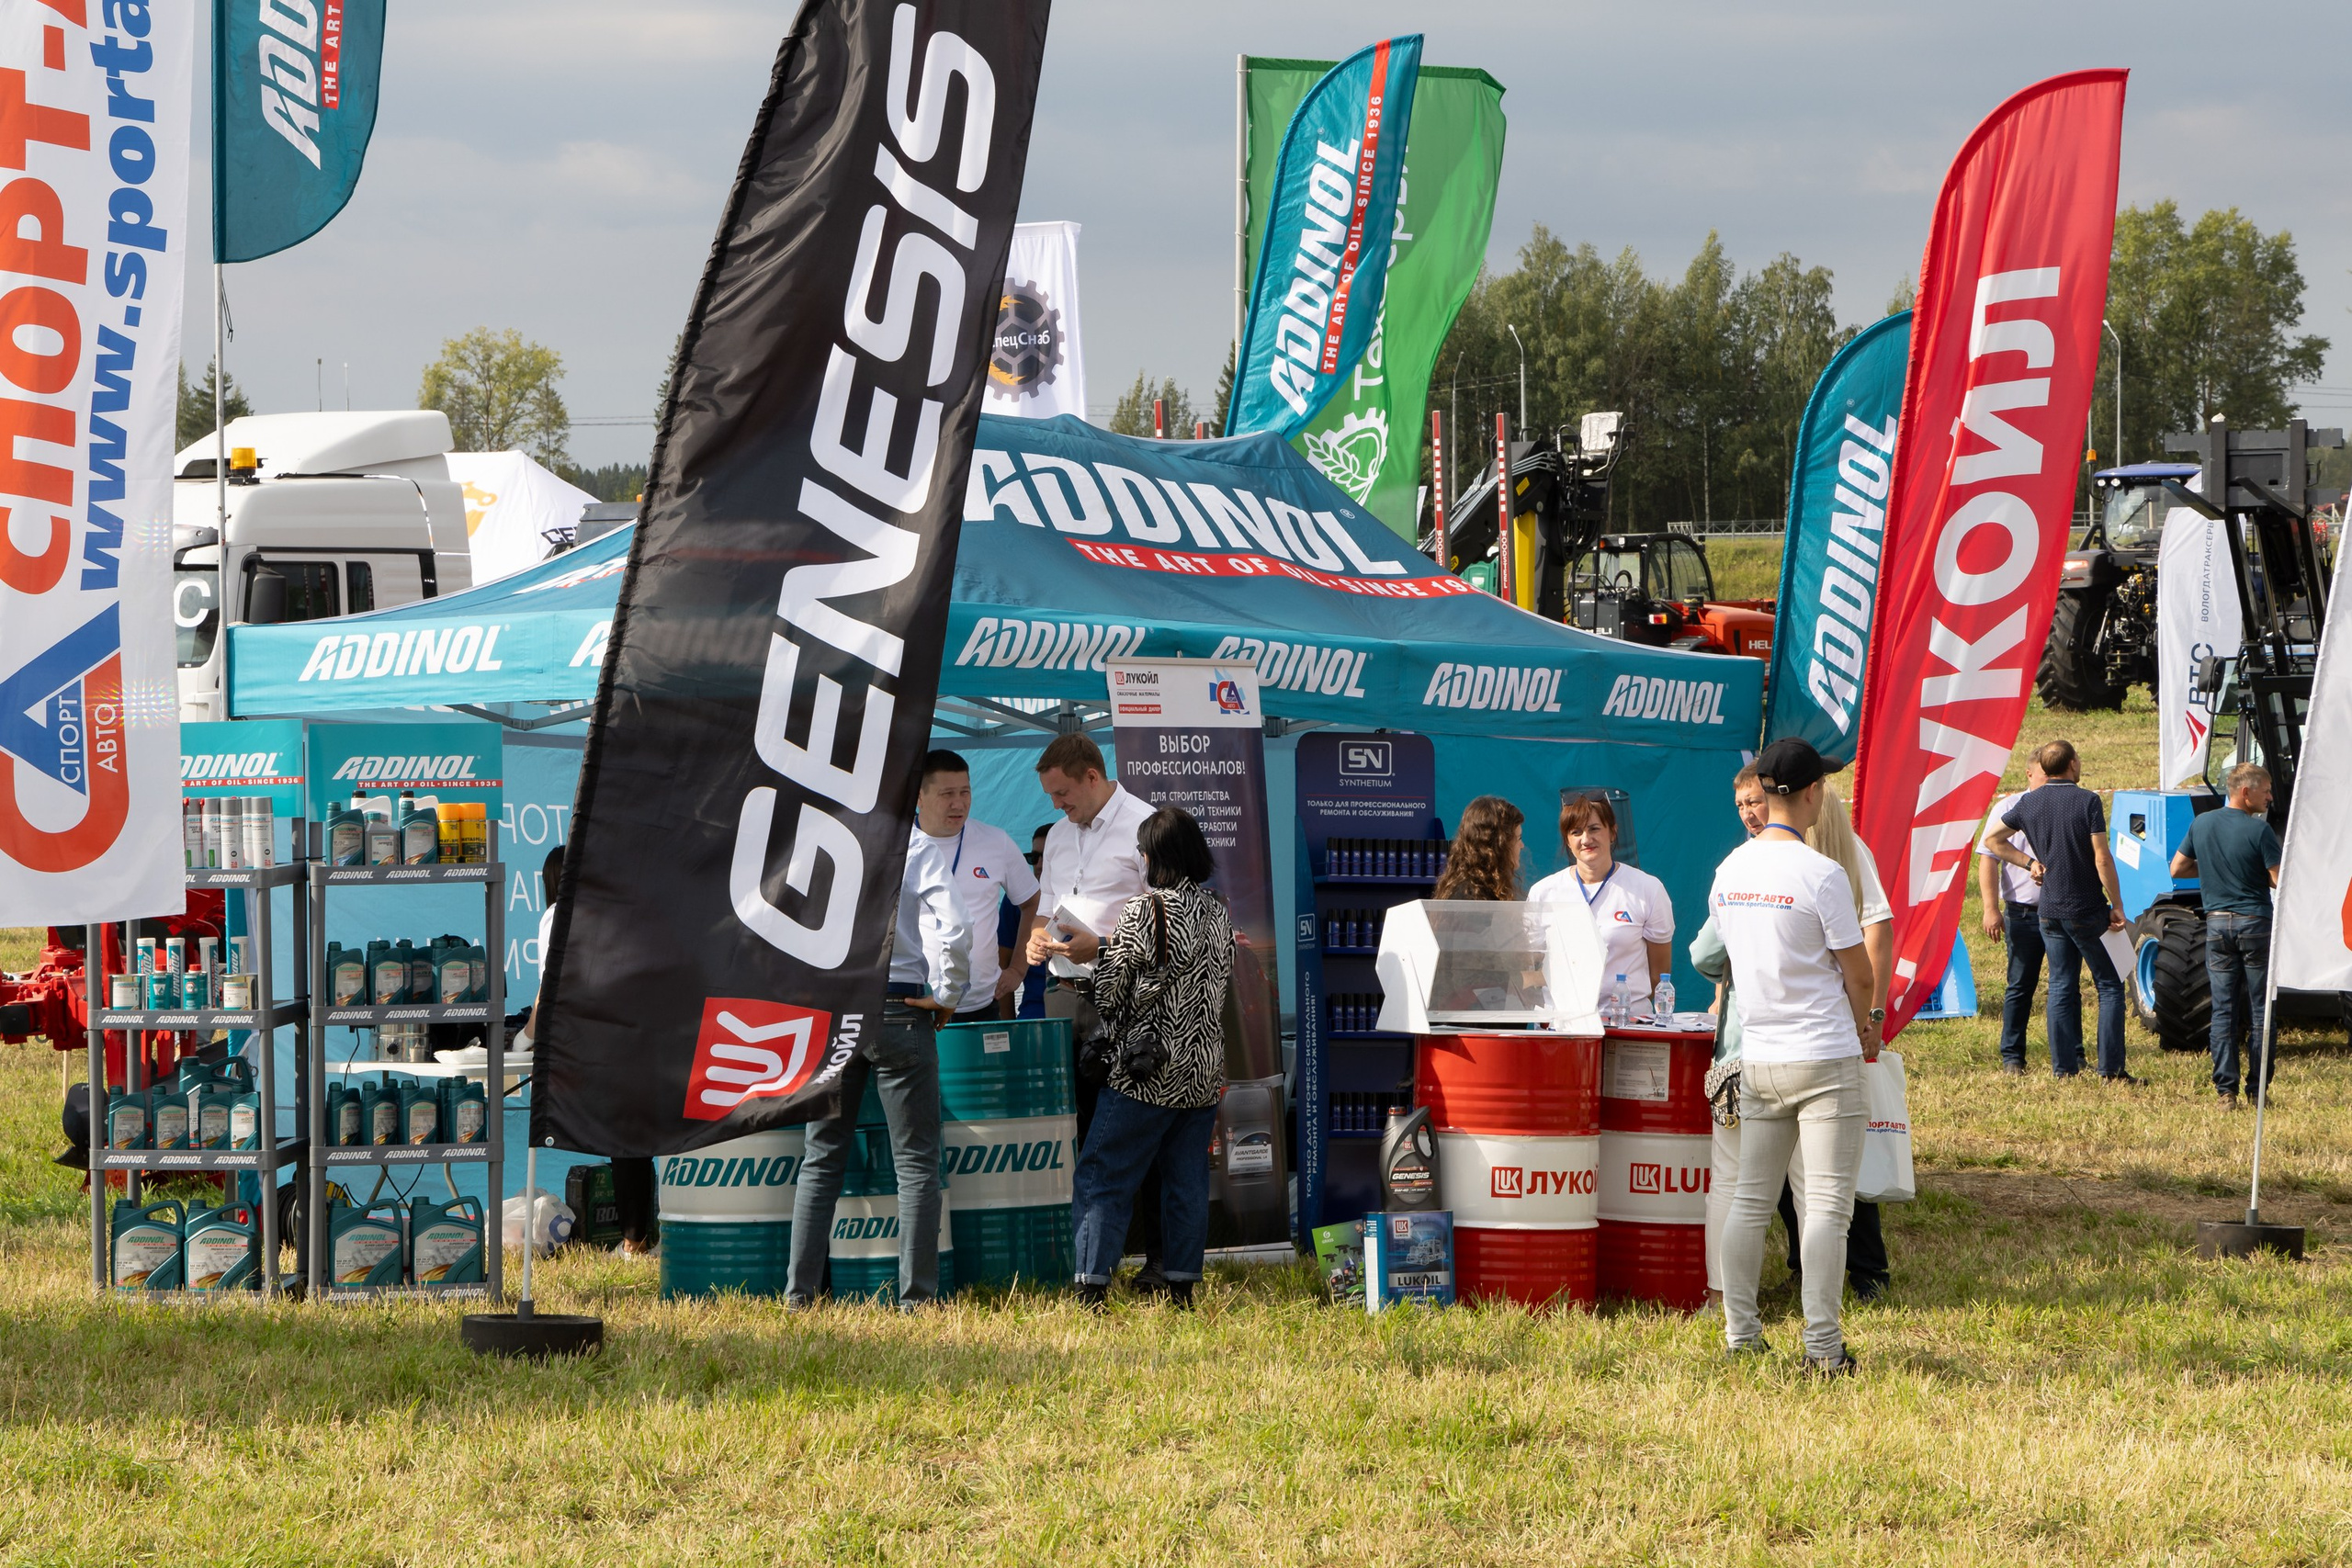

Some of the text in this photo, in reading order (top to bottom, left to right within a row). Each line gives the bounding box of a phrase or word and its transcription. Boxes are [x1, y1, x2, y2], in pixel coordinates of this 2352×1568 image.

[323, 5, 342, 105] THE ART
[1323, 335, 1340, 370] THE
[1332, 291, 1348, 325] ART
[1341, 262, 1354, 283] OF
[1366, 96, 1382, 139] 1936
[1271, 138, 1360, 416] ADDINOL
[993, 330, 1051, 349] пецСнаб
[729, 3, 996, 970] GENESIS
[963, 448, 1408, 575] ADDINOL
[1075, 543, 1148, 569] THE
[1154, 552, 1216, 574] ART
[1227, 557, 1270, 575] OF
[1430, 579, 1485, 595] 19
[1807, 412, 1896, 737] ADDINOL
[1908, 266, 2060, 907] ЛУКОЙЛ
[955, 616, 1147, 671] ADDINOL
[299, 625, 503, 682] ADDINOL
[1211, 636, 1369, 699] ADDINOL
[1125, 671, 1159, 684] ЛУКОЙЛ
[1422, 661, 1563, 713] ADDINOL
[1601, 674, 1724, 725] ADDINOL
[60, 695, 81, 784] СПОРТ
[96, 703, 119, 773] АВТО
[1159, 735, 1211, 753] ВЫБОР
[1348, 748, 1383, 769] SN
[333, 755, 477, 780] ADDINOL
[1127, 761, 1247, 776] ПРОФЕССИОНАЛОВ!
[1339, 779, 1392, 787] SYNTHETIUM
[1150, 790, 1230, 803] ДЛЯ СТРОИТЕЛЬСТВА
[1351, 801, 1427, 809] ПРОФЕССИОНАЛЬНОГО
[1207, 806, 1242, 817] ТЕХНИКИ
[208, 874, 251, 883] ADDINOL
[329, 871, 374, 879] ADDINOL
[386, 870, 431, 878] ADDINOL
[443, 868, 488, 877] ADDINOL
[1727, 892, 1794, 905] СПОРТ-АВТО
[327, 1011, 373, 1021] ADDINOL
[385, 1010, 431, 1019] ADDINOL
[442, 1008, 488, 1017] ADDINOL
[101, 1015, 144, 1024] ADDINOL
[155, 1015, 199, 1024] ADDINOL
[210, 1015, 254, 1024] ADDINOL
[327, 1151, 372, 1161] ADDINOL
[384, 1149, 429, 1159] ADDINOL
[441, 1147, 487, 1157] ADDINOL
[104, 1155, 147, 1164] ADDINOL
[159, 1156, 202, 1164] ADDINOL
[213, 1156, 257, 1165] ADDINOL
[1392, 1172, 1430, 1180] GENESIS
[127, 1235, 165, 1244] ADDINOL
[347, 1234, 387, 1242] ADDINOL
[426, 1232, 465, 1240] ADDINOL
[1397, 1274, 1442, 1286] LUKOIL
